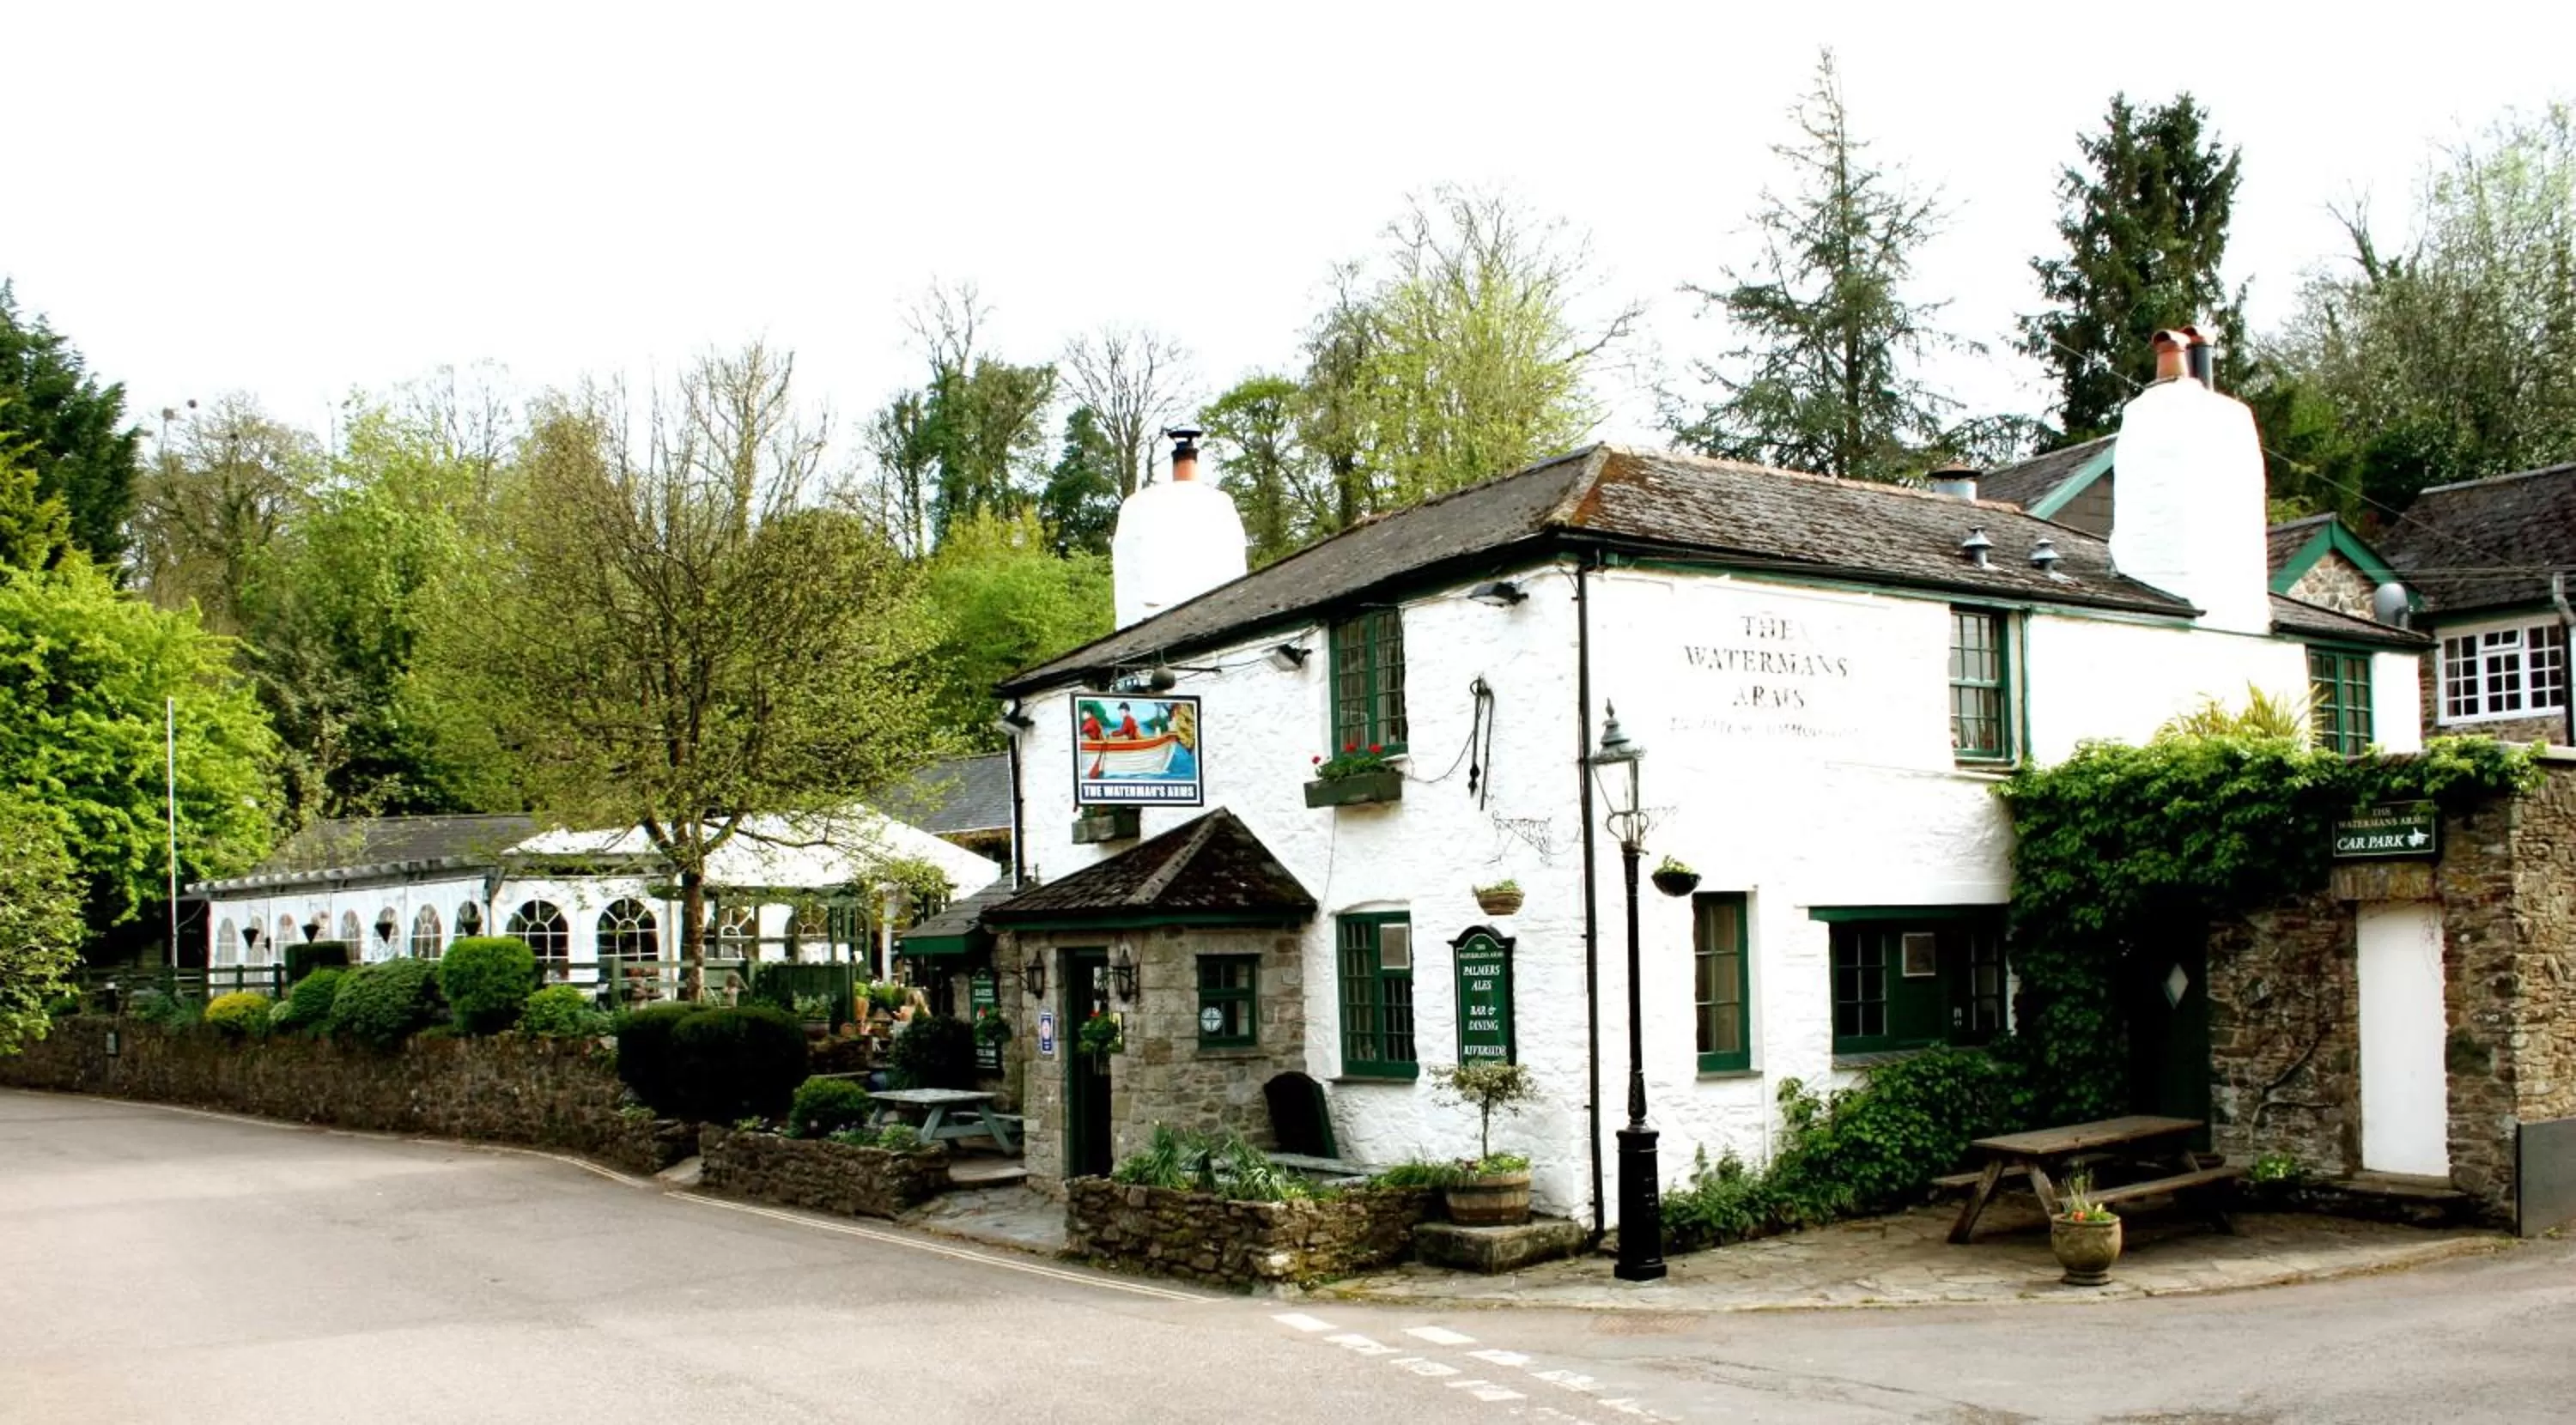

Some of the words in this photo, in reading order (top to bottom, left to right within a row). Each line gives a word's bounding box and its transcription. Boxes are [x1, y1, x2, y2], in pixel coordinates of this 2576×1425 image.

[1741, 615, 1794, 640] THE
[1684, 645, 1848, 677] WATERMANS
[1733, 685, 1804, 708] ARMS
[1083, 785, 1103, 797] THE
[1167, 785, 1194, 797] ARMS
[2336, 836, 2366, 851] CAR
[2368, 834, 2405, 848] PARK
[1463, 964, 1501, 976] PALMERS
[1472, 979, 1492, 991] ALES
[1470, 1005, 1486, 1016] BAR
[1468, 1019, 1498, 1031] DINING
